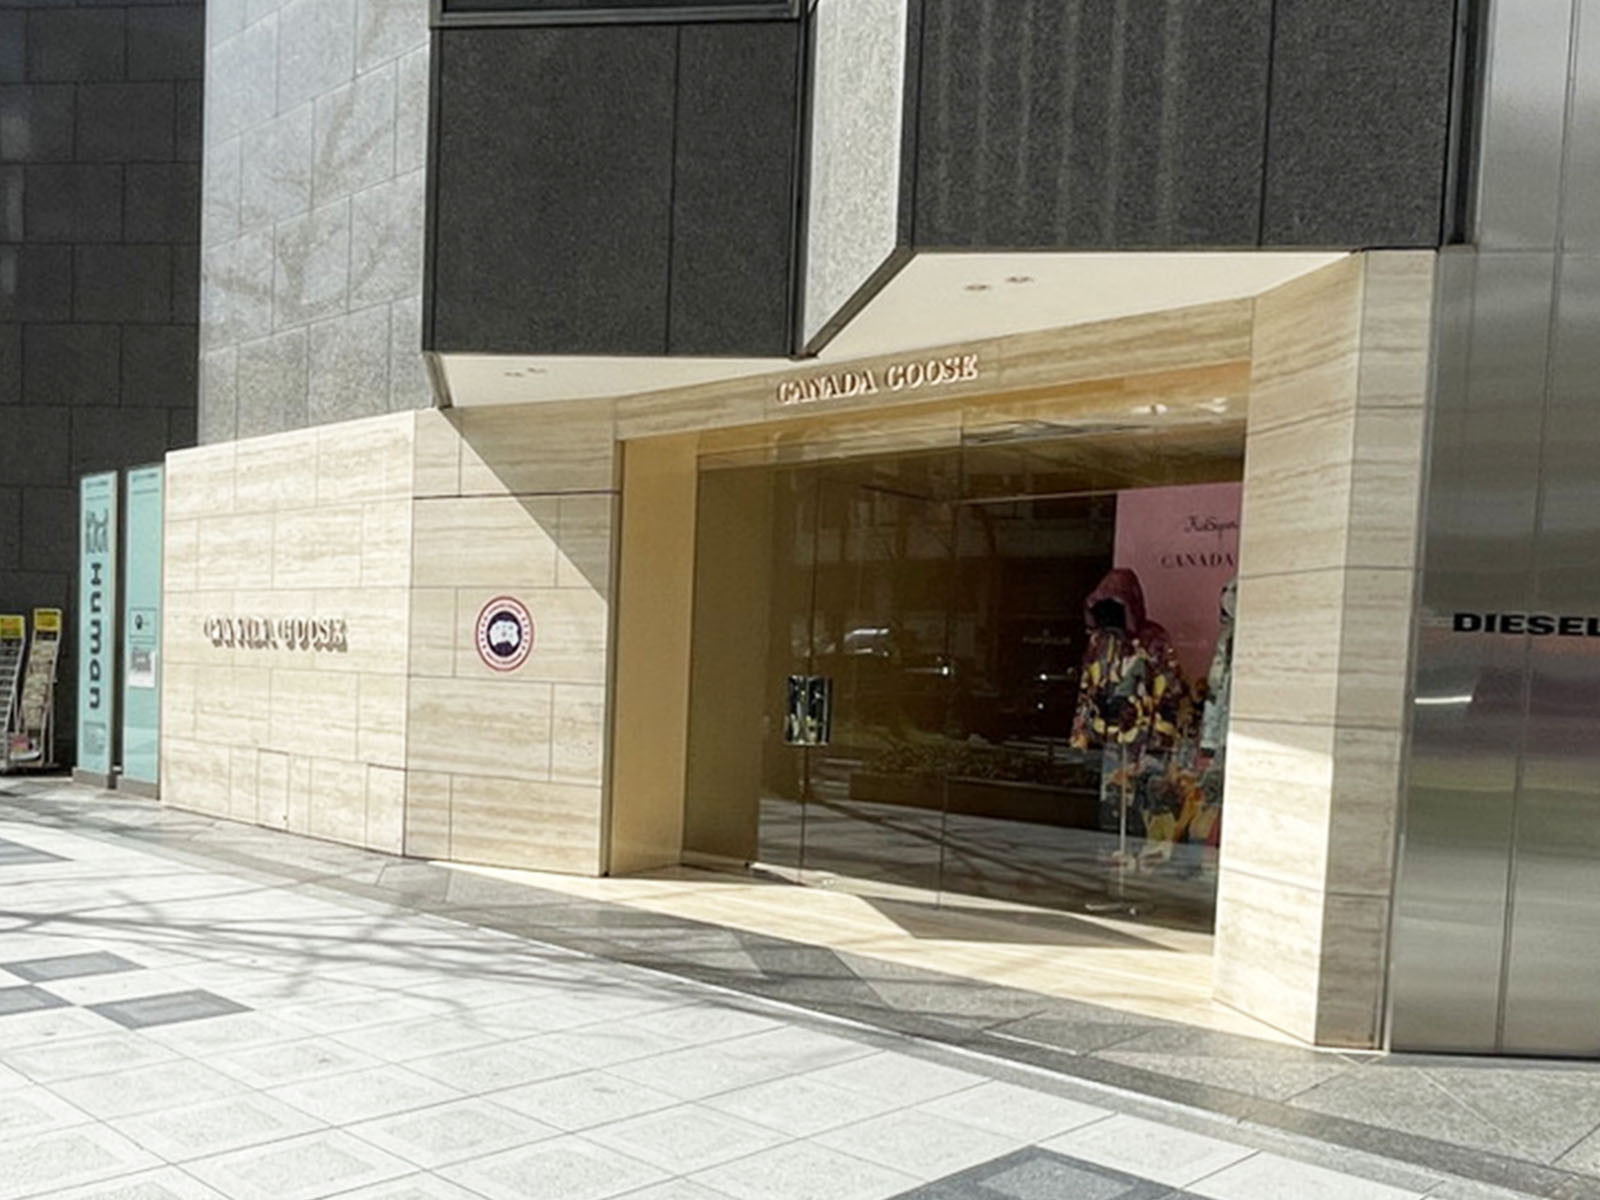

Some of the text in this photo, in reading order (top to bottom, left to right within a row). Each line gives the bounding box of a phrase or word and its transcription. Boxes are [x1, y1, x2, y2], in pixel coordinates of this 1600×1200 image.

[777, 354, 979, 405] CANADA GOOSE
[1160, 553, 1235, 569] CANADA
[88, 562, 103, 710] Human
[1453, 613, 1600, 636] DIESEL
